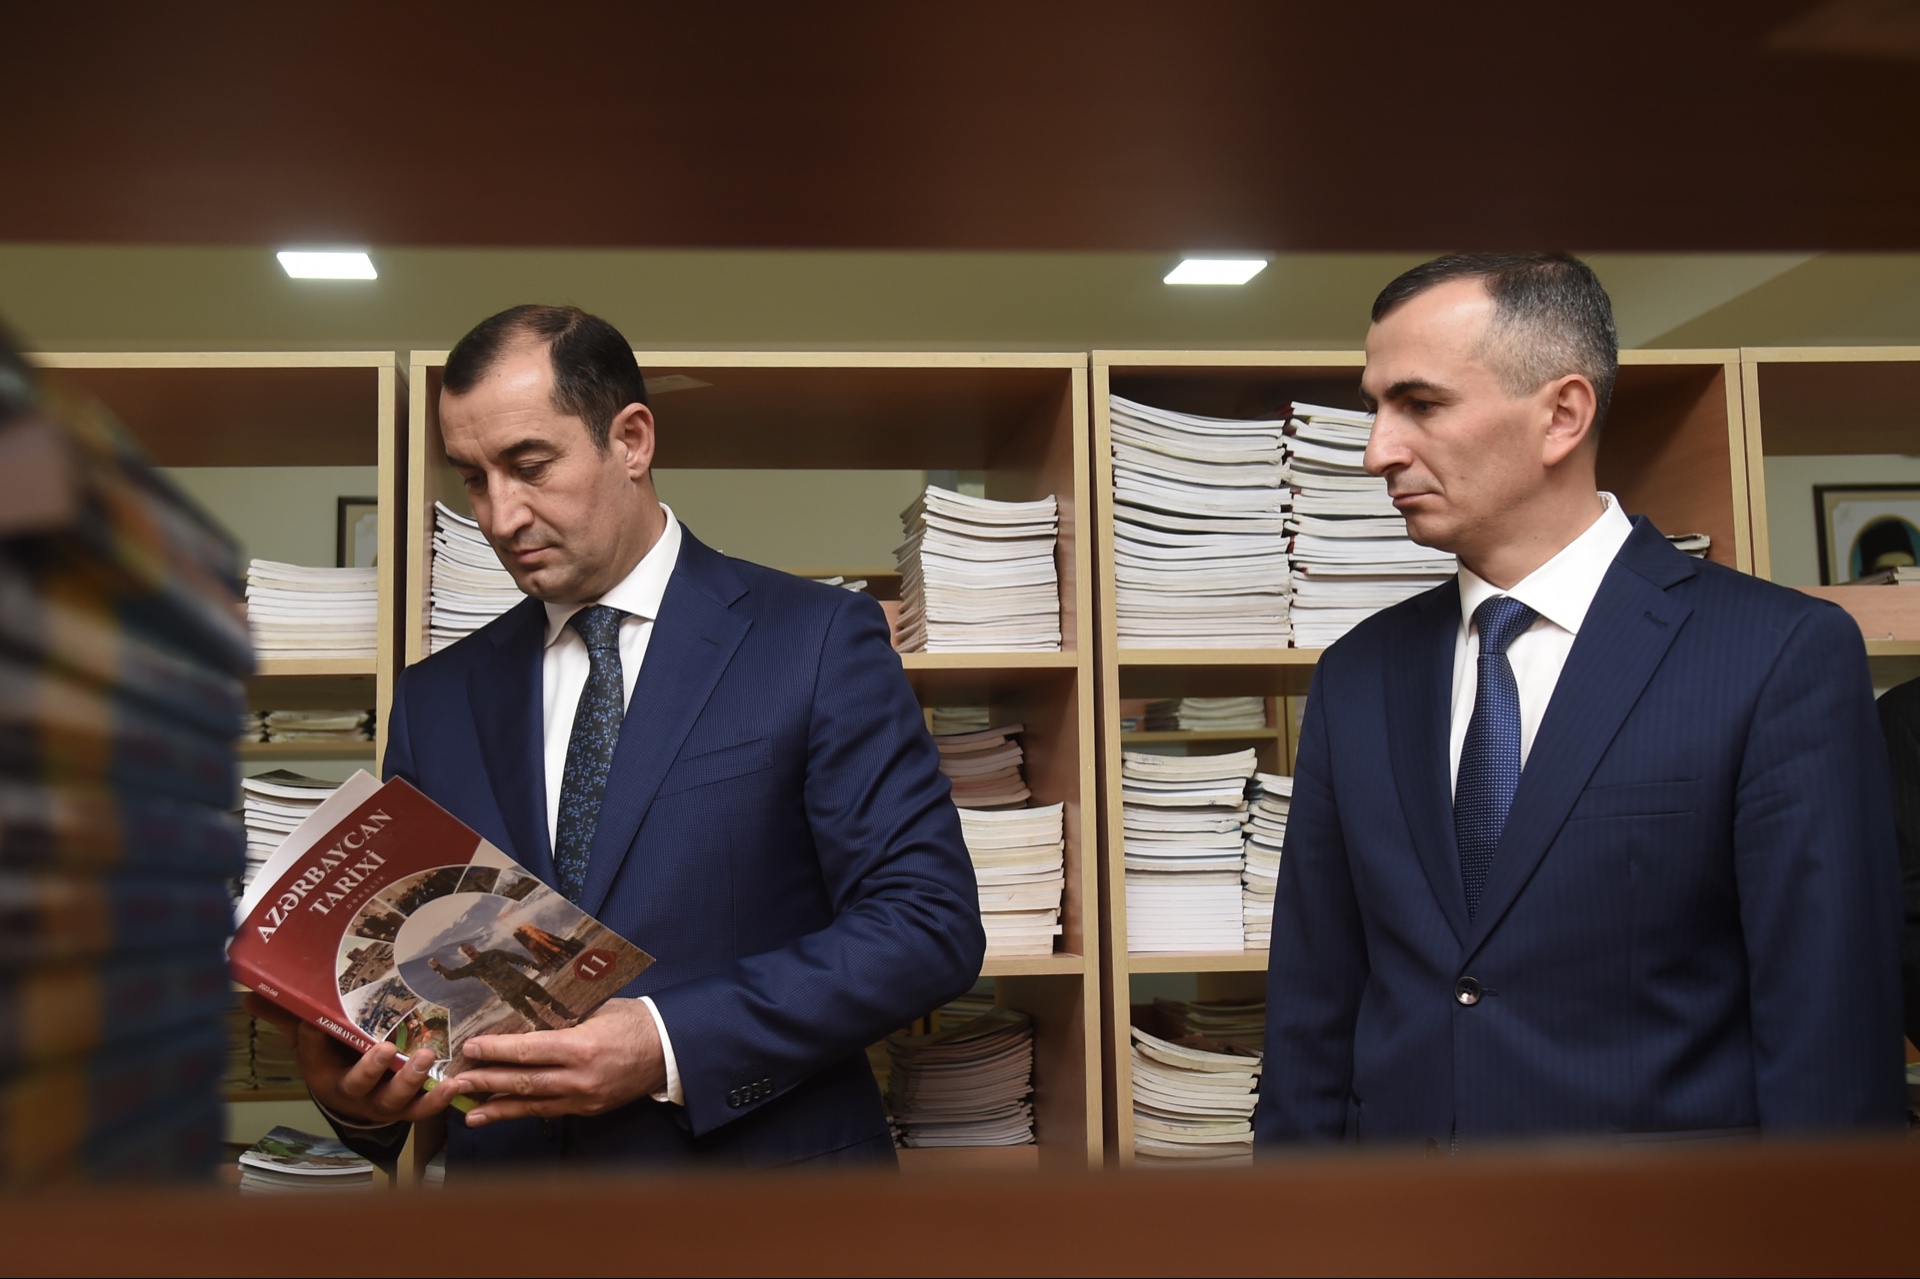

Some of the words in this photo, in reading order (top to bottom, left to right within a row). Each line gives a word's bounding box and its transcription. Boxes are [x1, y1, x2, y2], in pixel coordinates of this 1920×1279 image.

[257, 808, 394, 944] AZƏRBAYCAN
[309, 849, 388, 916] TARİXİ
[580, 954, 609, 978] 11
[316, 1016, 367, 1049] AZƏRBAYCAN
